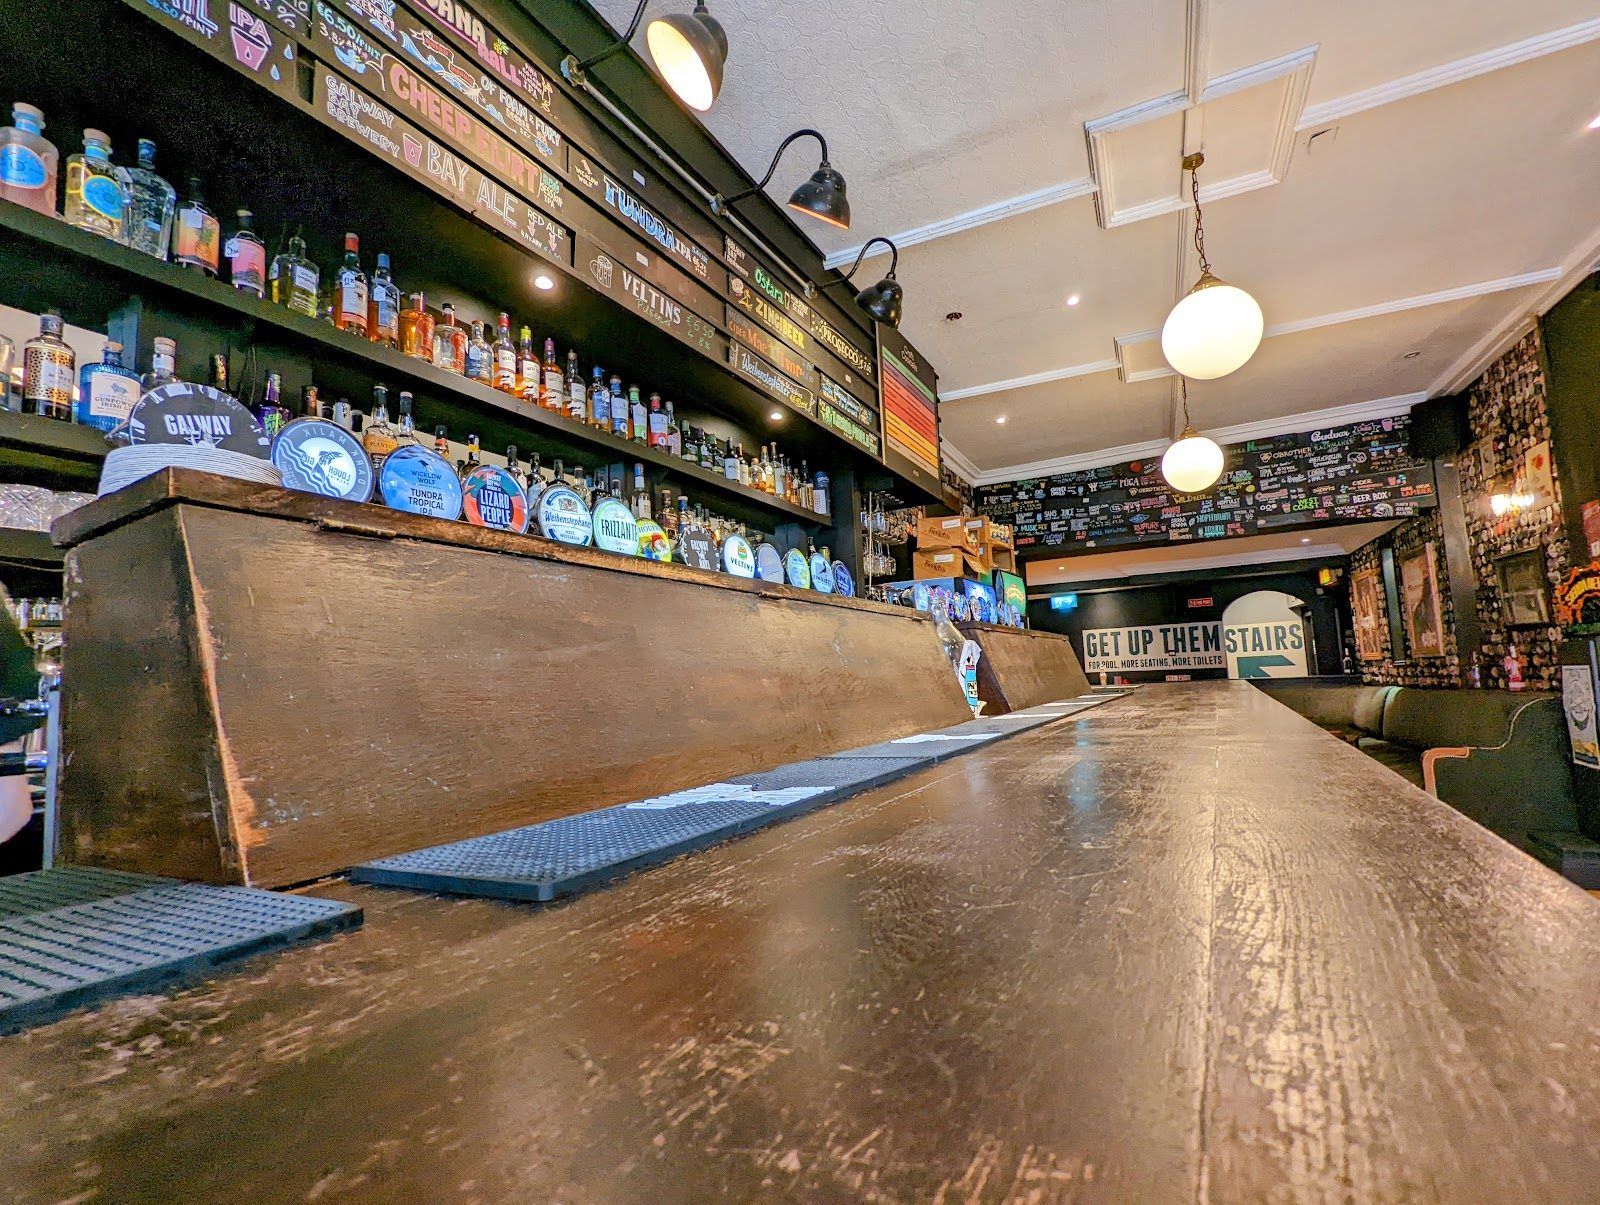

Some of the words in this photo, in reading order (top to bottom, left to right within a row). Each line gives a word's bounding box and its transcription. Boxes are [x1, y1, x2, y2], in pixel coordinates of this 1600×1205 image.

[230, 2, 272, 46] IPA
[481, 75, 497, 95] OF
[523, 79, 538, 99] IPA
[326, 75, 395, 128] GALWAY
[327, 88, 361, 120] BAY
[390, 63, 472, 142] CHEEP
[327, 100, 401, 158] BREWERY
[427, 140, 469, 193] BAY
[477, 176, 519, 226] ALE
[527, 208, 545, 226] RED
[546, 222, 563, 241] ALE
[603, 174, 676, 253] TUNDRA
[675, 238, 692, 263] IPA
[622, 270, 681, 325] VELTINS
[755, 297, 804, 349] ZINGIBEER
[822, 325, 859, 364] PROSECCO
[164, 414, 232, 436] GALWAY
[411, 470, 442, 480] WICKLOW
[417, 477, 436, 486] WOLF
[408, 496, 445, 511] TROPICAL
[410, 488, 443, 502] TUNDRA
[480, 488, 510, 509] LIZARD
[1297, 496, 1319, 505] WEST
[1352, 494, 1371, 504] BEER
[1372, 491, 1388, 501] BOX
[419, 507, 433, 516] IPA
[481, 506, 512, 525] PEOPLE
[1293, 502, 1319, 512] COAST
[730, 557, 754, 573] VELTINS
[1086, 631, 1121, 658] GET
[1128, 629, 1153, 656] UP
[1160, 624, 1222, 654] THEM
[1224, 624, 1304, 654] STAIRS
[1089, 661, 1100, 670] FOR
[1121, 658, 1139, 668] MORE
[1172, 656, 1192, 666] MORE
[1193, 655, 1223, 666] TOILETS
